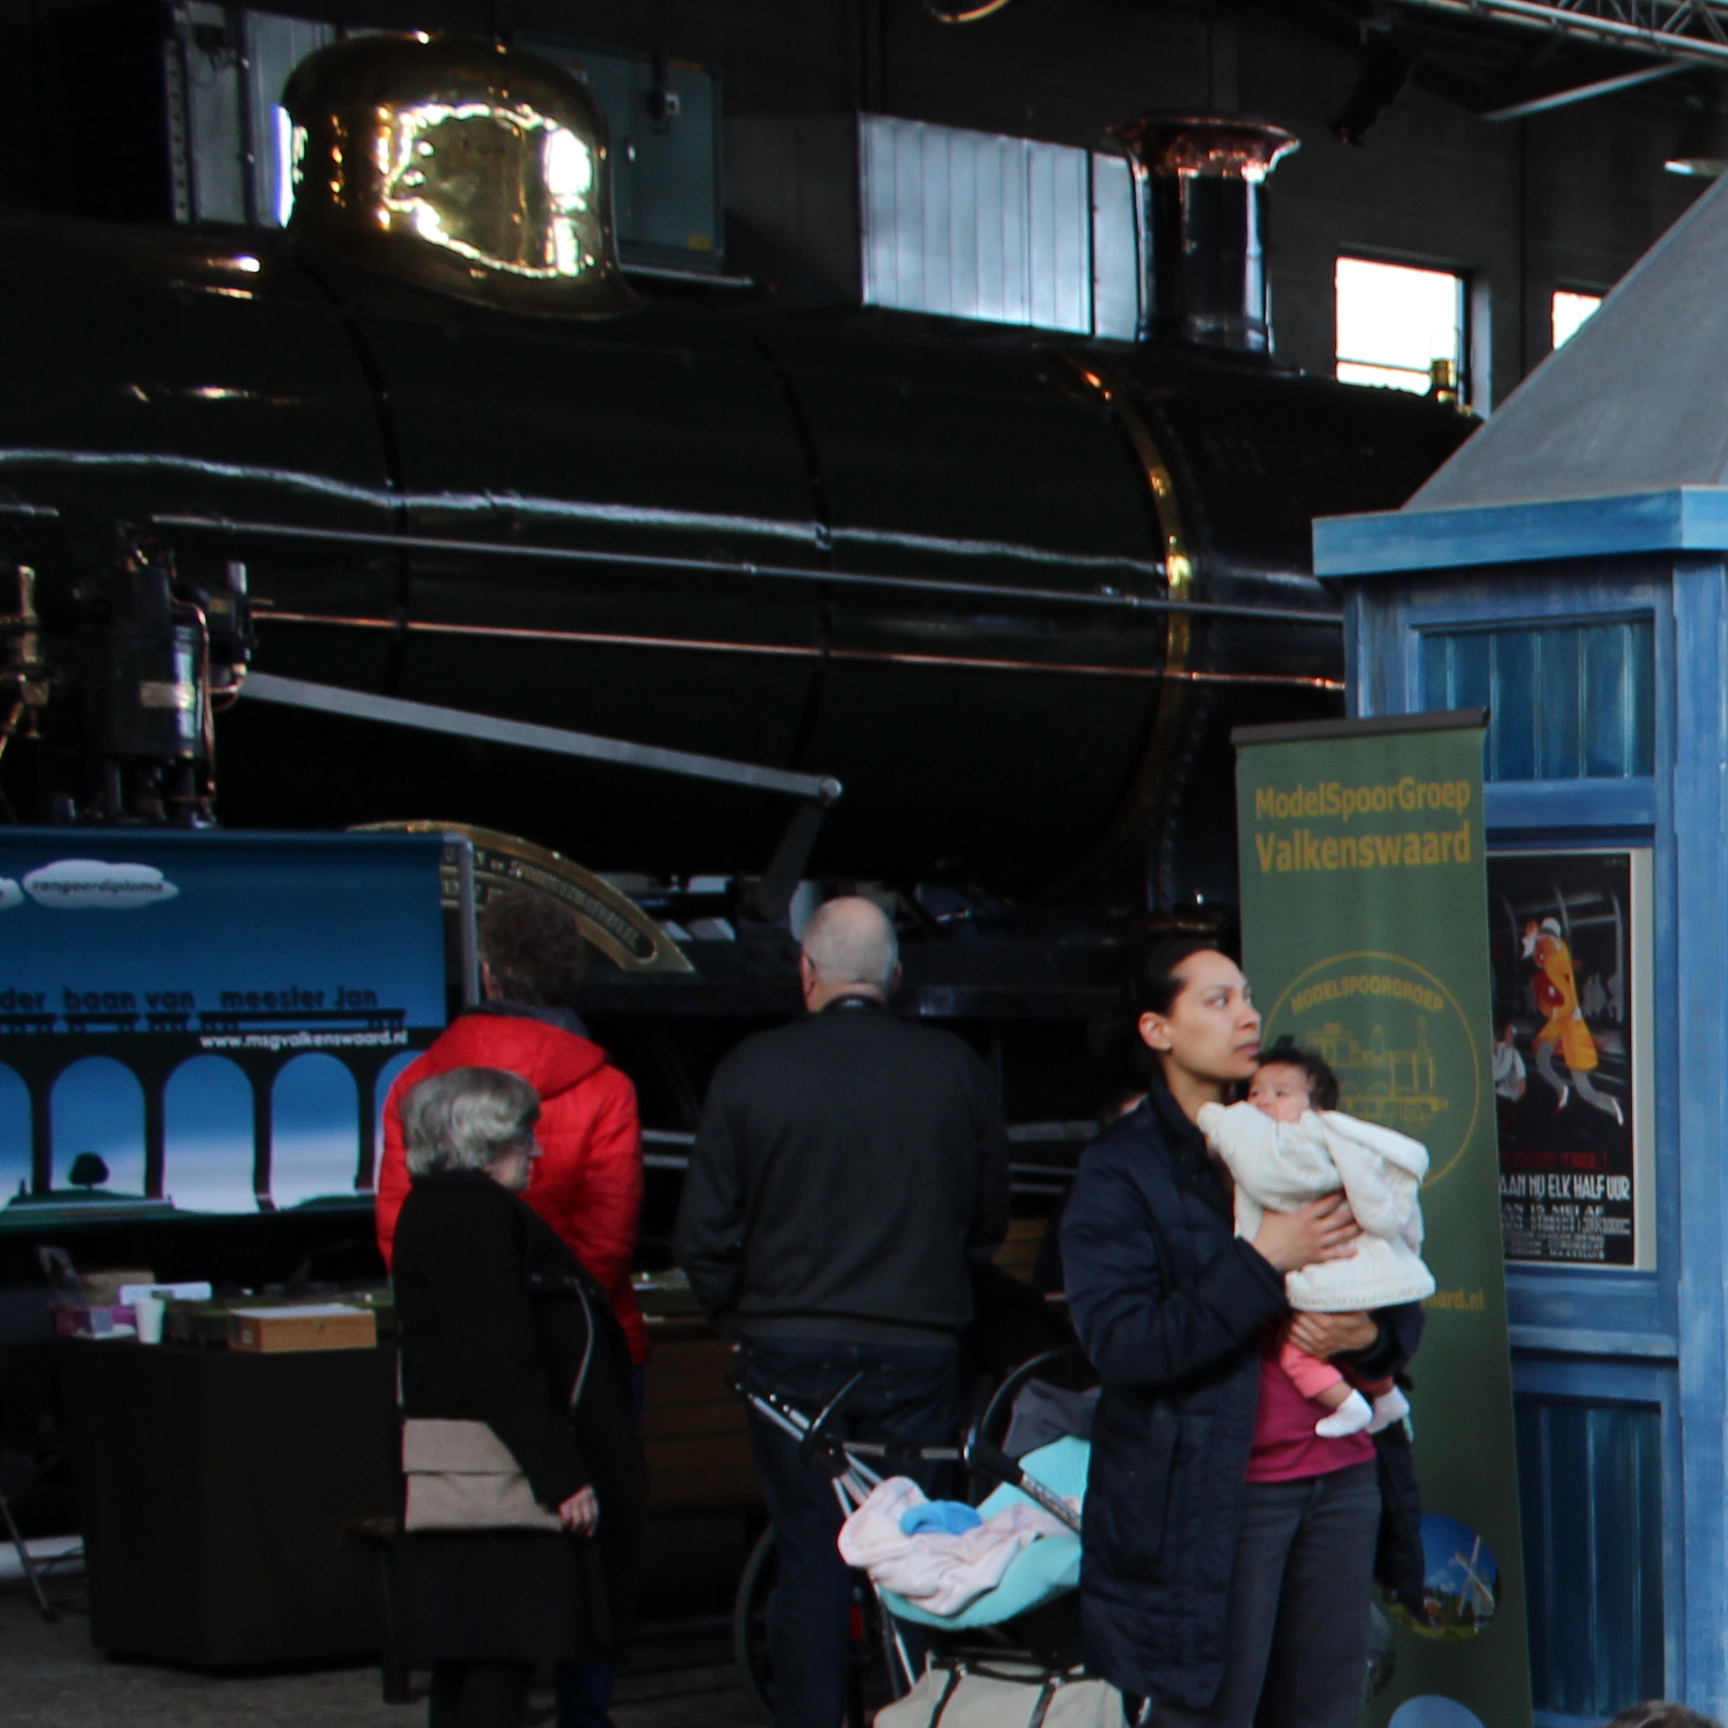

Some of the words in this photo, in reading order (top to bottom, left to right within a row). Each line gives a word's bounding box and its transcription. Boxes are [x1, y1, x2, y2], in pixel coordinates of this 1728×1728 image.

[1254, 776, 1471, 822] ModelSpoorGroep
[1254, 819, 1471, 872] Valkenswaard
[63, 986, 137, 1011] baan
[145, 990, 195, 1011] van
[221, 985, 325, 1010] meester
[1290, 974, 1445, 1014] MODELSPOORGROEP
[1528, 1174, 1546, 1198] NU
[1549, 1174, 1571, 1198] ELK
[1573, 1174, 1604, 1199] HALF
[1606, 1176, 1630, 1200] UUR
